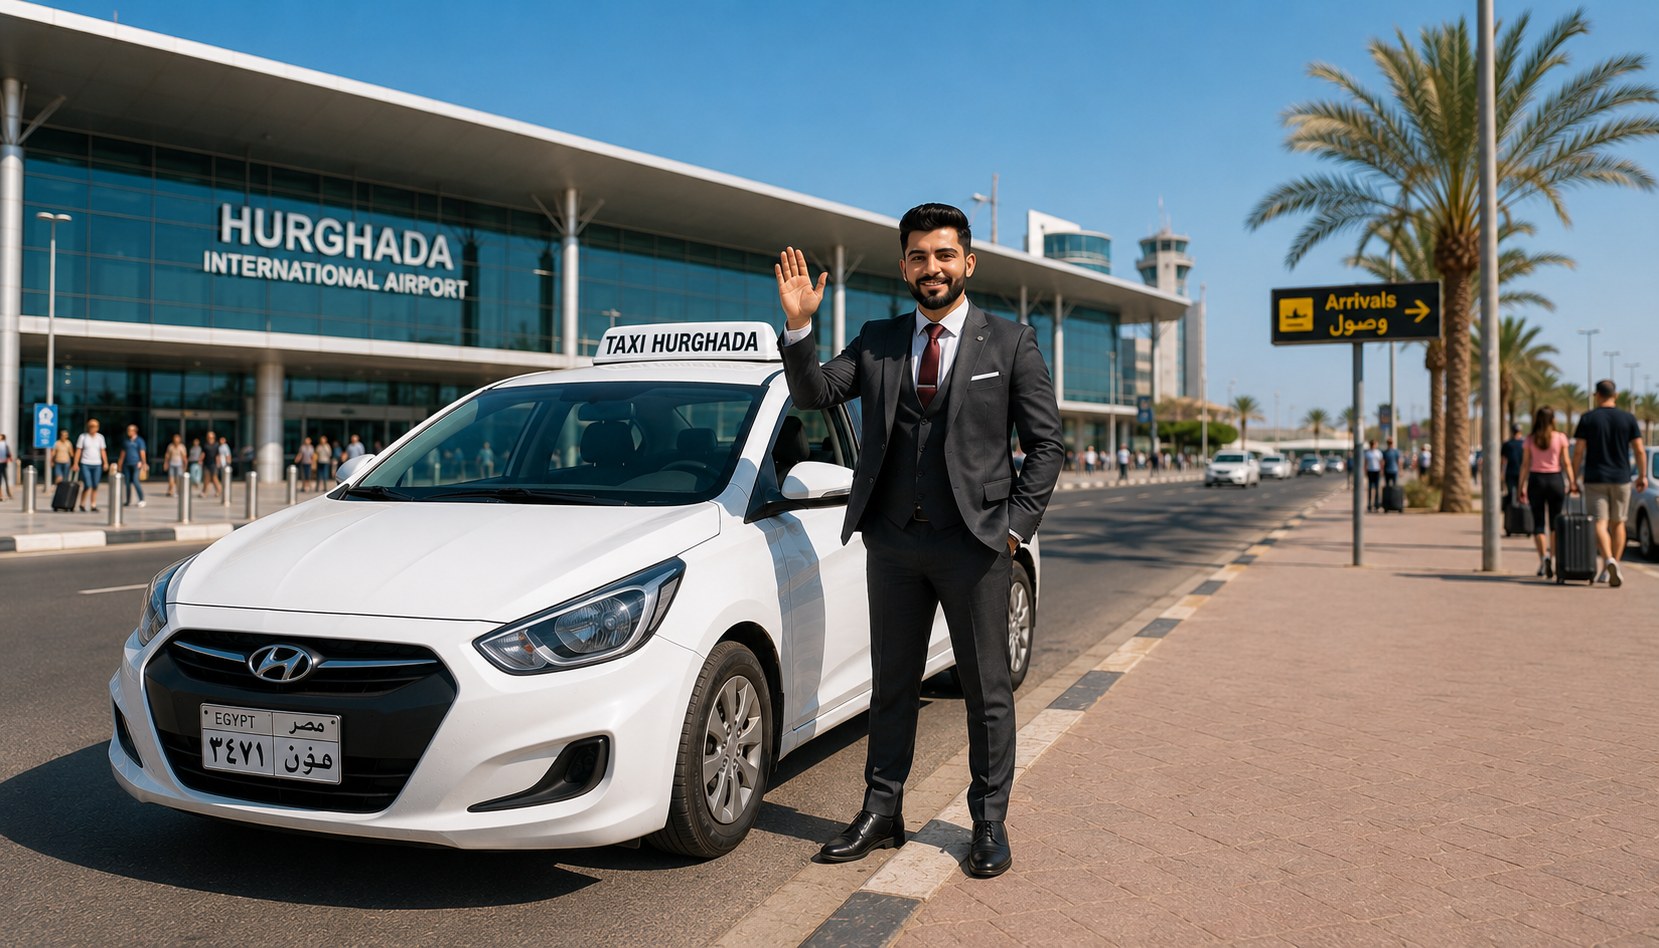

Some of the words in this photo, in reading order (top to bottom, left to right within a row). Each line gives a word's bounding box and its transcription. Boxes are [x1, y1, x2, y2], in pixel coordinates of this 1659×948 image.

[220, 203, 455, 271] HURGHADA
[203, 250, 380, 291] INTERNATIONAL
[383, 271, 469, 300] AIRPORT
[1325, 291, 1397, 311] Arrivals
[1329, 314, 1388, 336] وصول
[606, 334, 647, 355] TAXI
[651, 331, 758, 353] HURGHADA
[214, 711, 256, 729] EGYPT
[289, 720, 325, 735] مصر
[209, 736, 264, 768] ٣٤٧١
